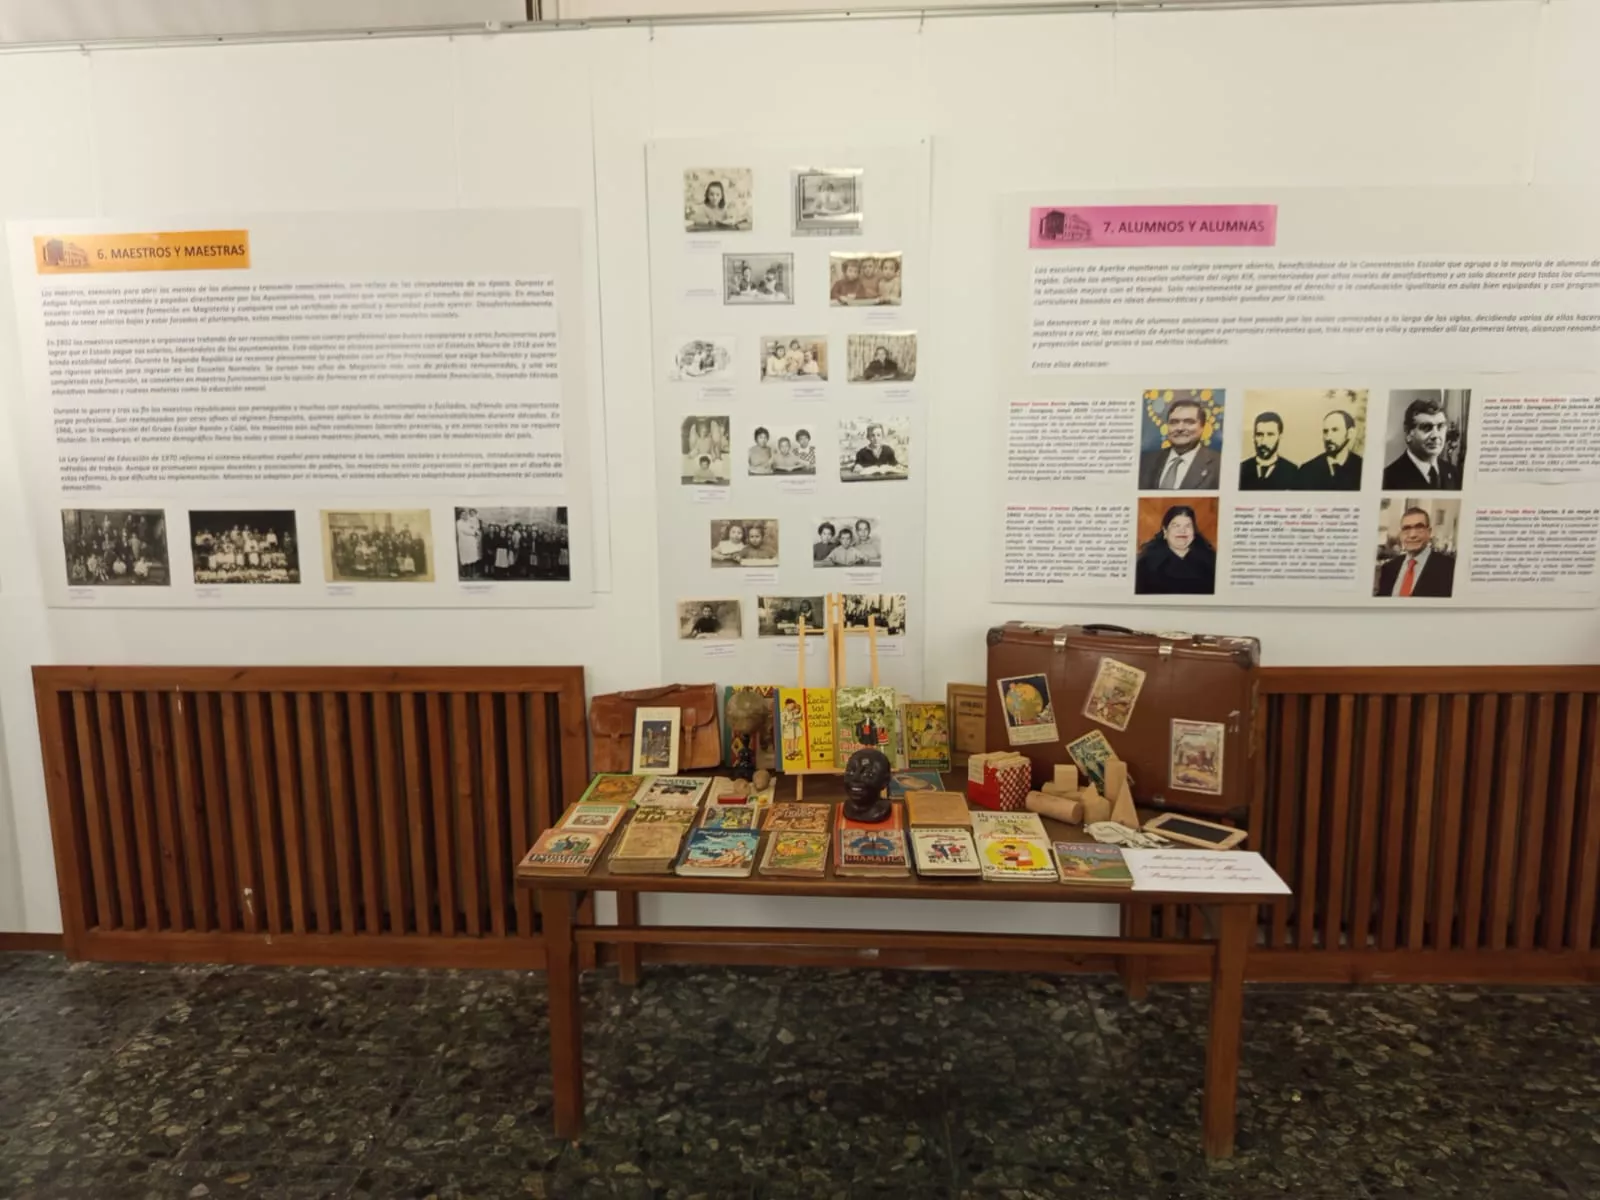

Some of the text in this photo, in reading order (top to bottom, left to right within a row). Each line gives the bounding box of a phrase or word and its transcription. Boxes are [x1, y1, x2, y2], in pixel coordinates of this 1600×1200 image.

[1103, 220, 1265, 233] 7. ALUMNOS Y ALUMNAS
[97, 244, 245, 260] 6. MAESTROS Y MAESTRAS
